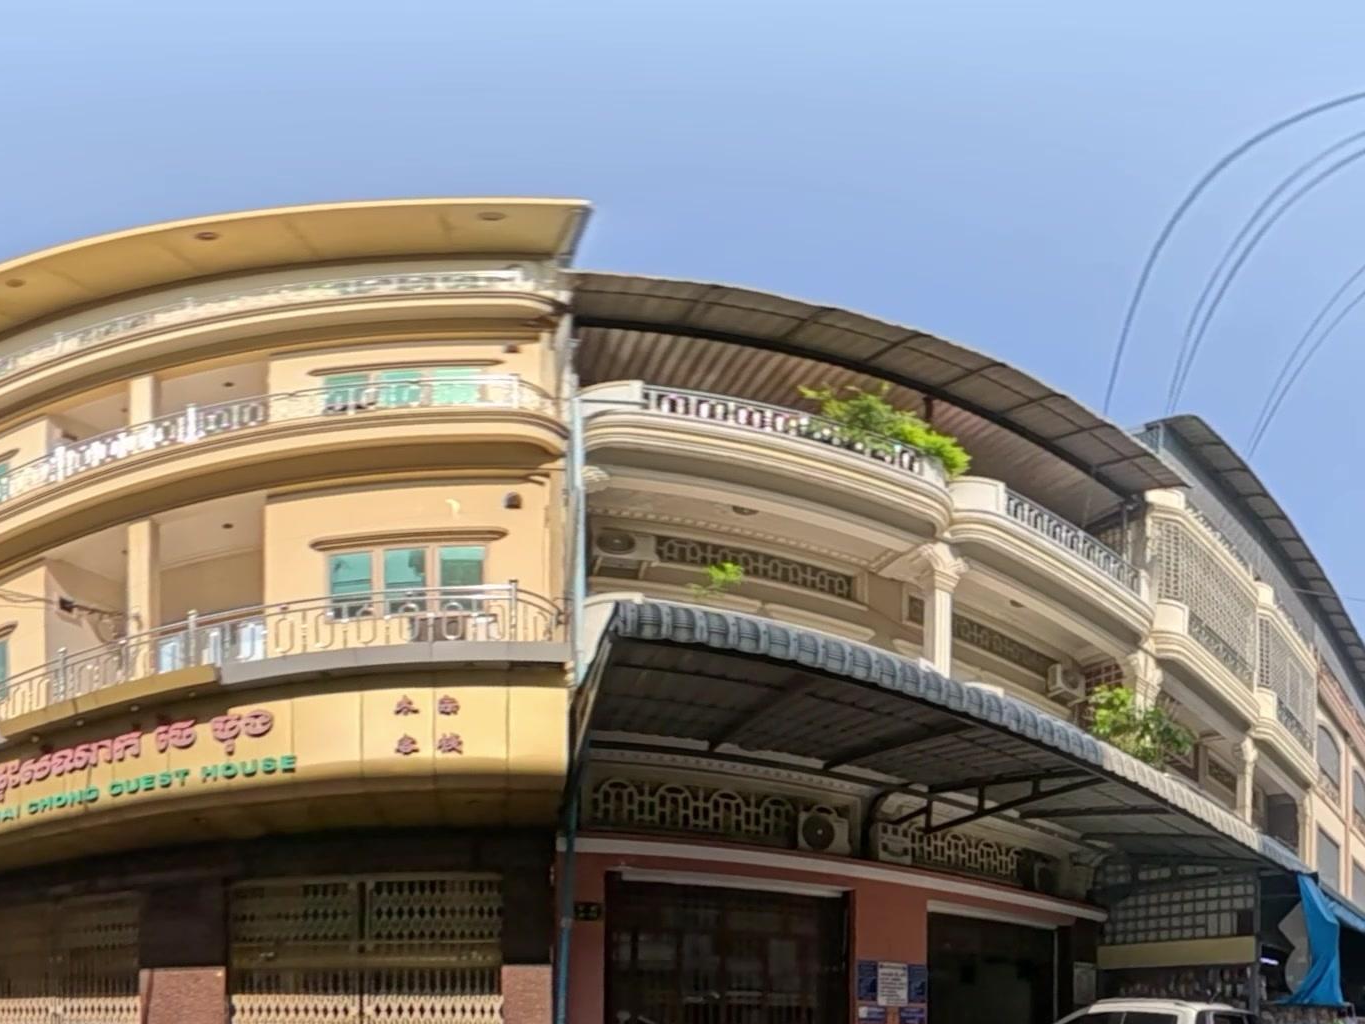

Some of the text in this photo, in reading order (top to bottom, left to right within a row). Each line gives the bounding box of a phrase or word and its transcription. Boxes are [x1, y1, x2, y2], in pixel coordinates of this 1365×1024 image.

[27, 786, 100, 815] CHONG
[108, 769, 191, 797] GUEST
[200, 755, 297, 783] HOUSE
